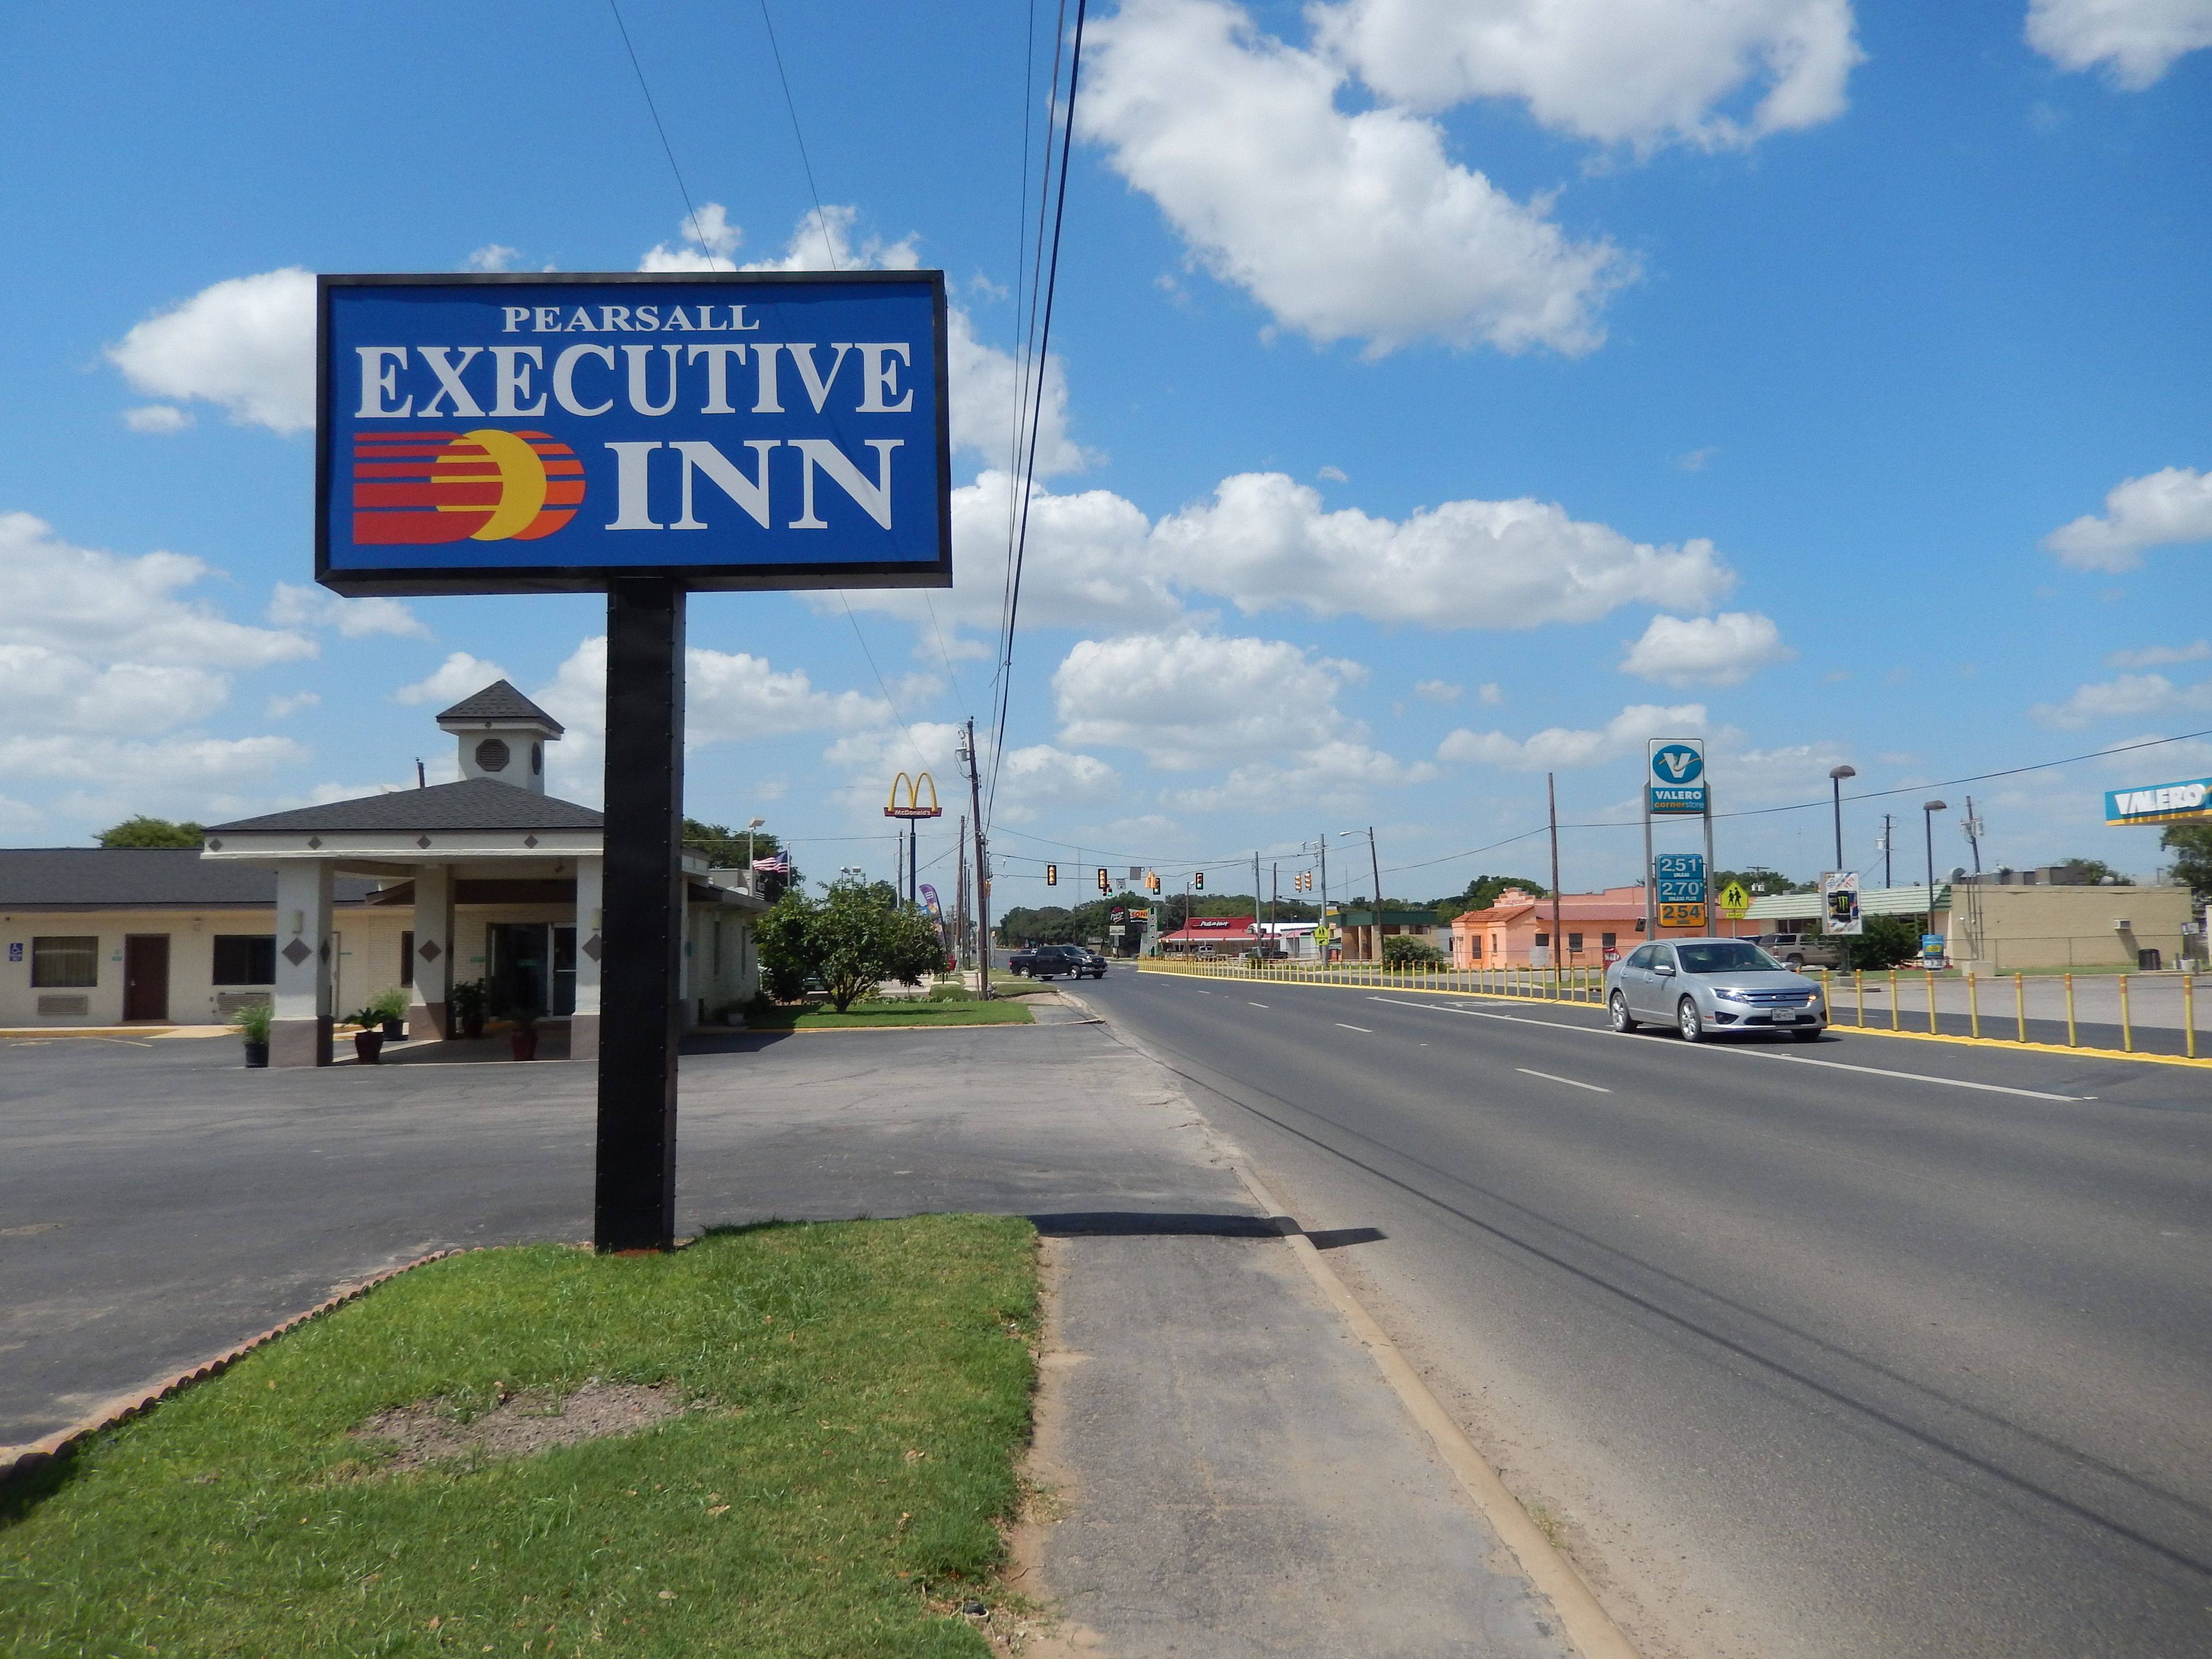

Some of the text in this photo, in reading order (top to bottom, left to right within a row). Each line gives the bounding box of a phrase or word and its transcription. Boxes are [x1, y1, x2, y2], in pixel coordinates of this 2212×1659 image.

[502, 305, 760, 332] PEARSALL
[354, 342, 915, 418] EXECUTIVE
[604, 438, 905, 531] INN
[1655, 790, 1702, 800] VALERO
[2115, 783, 2206, 815] VALERO
